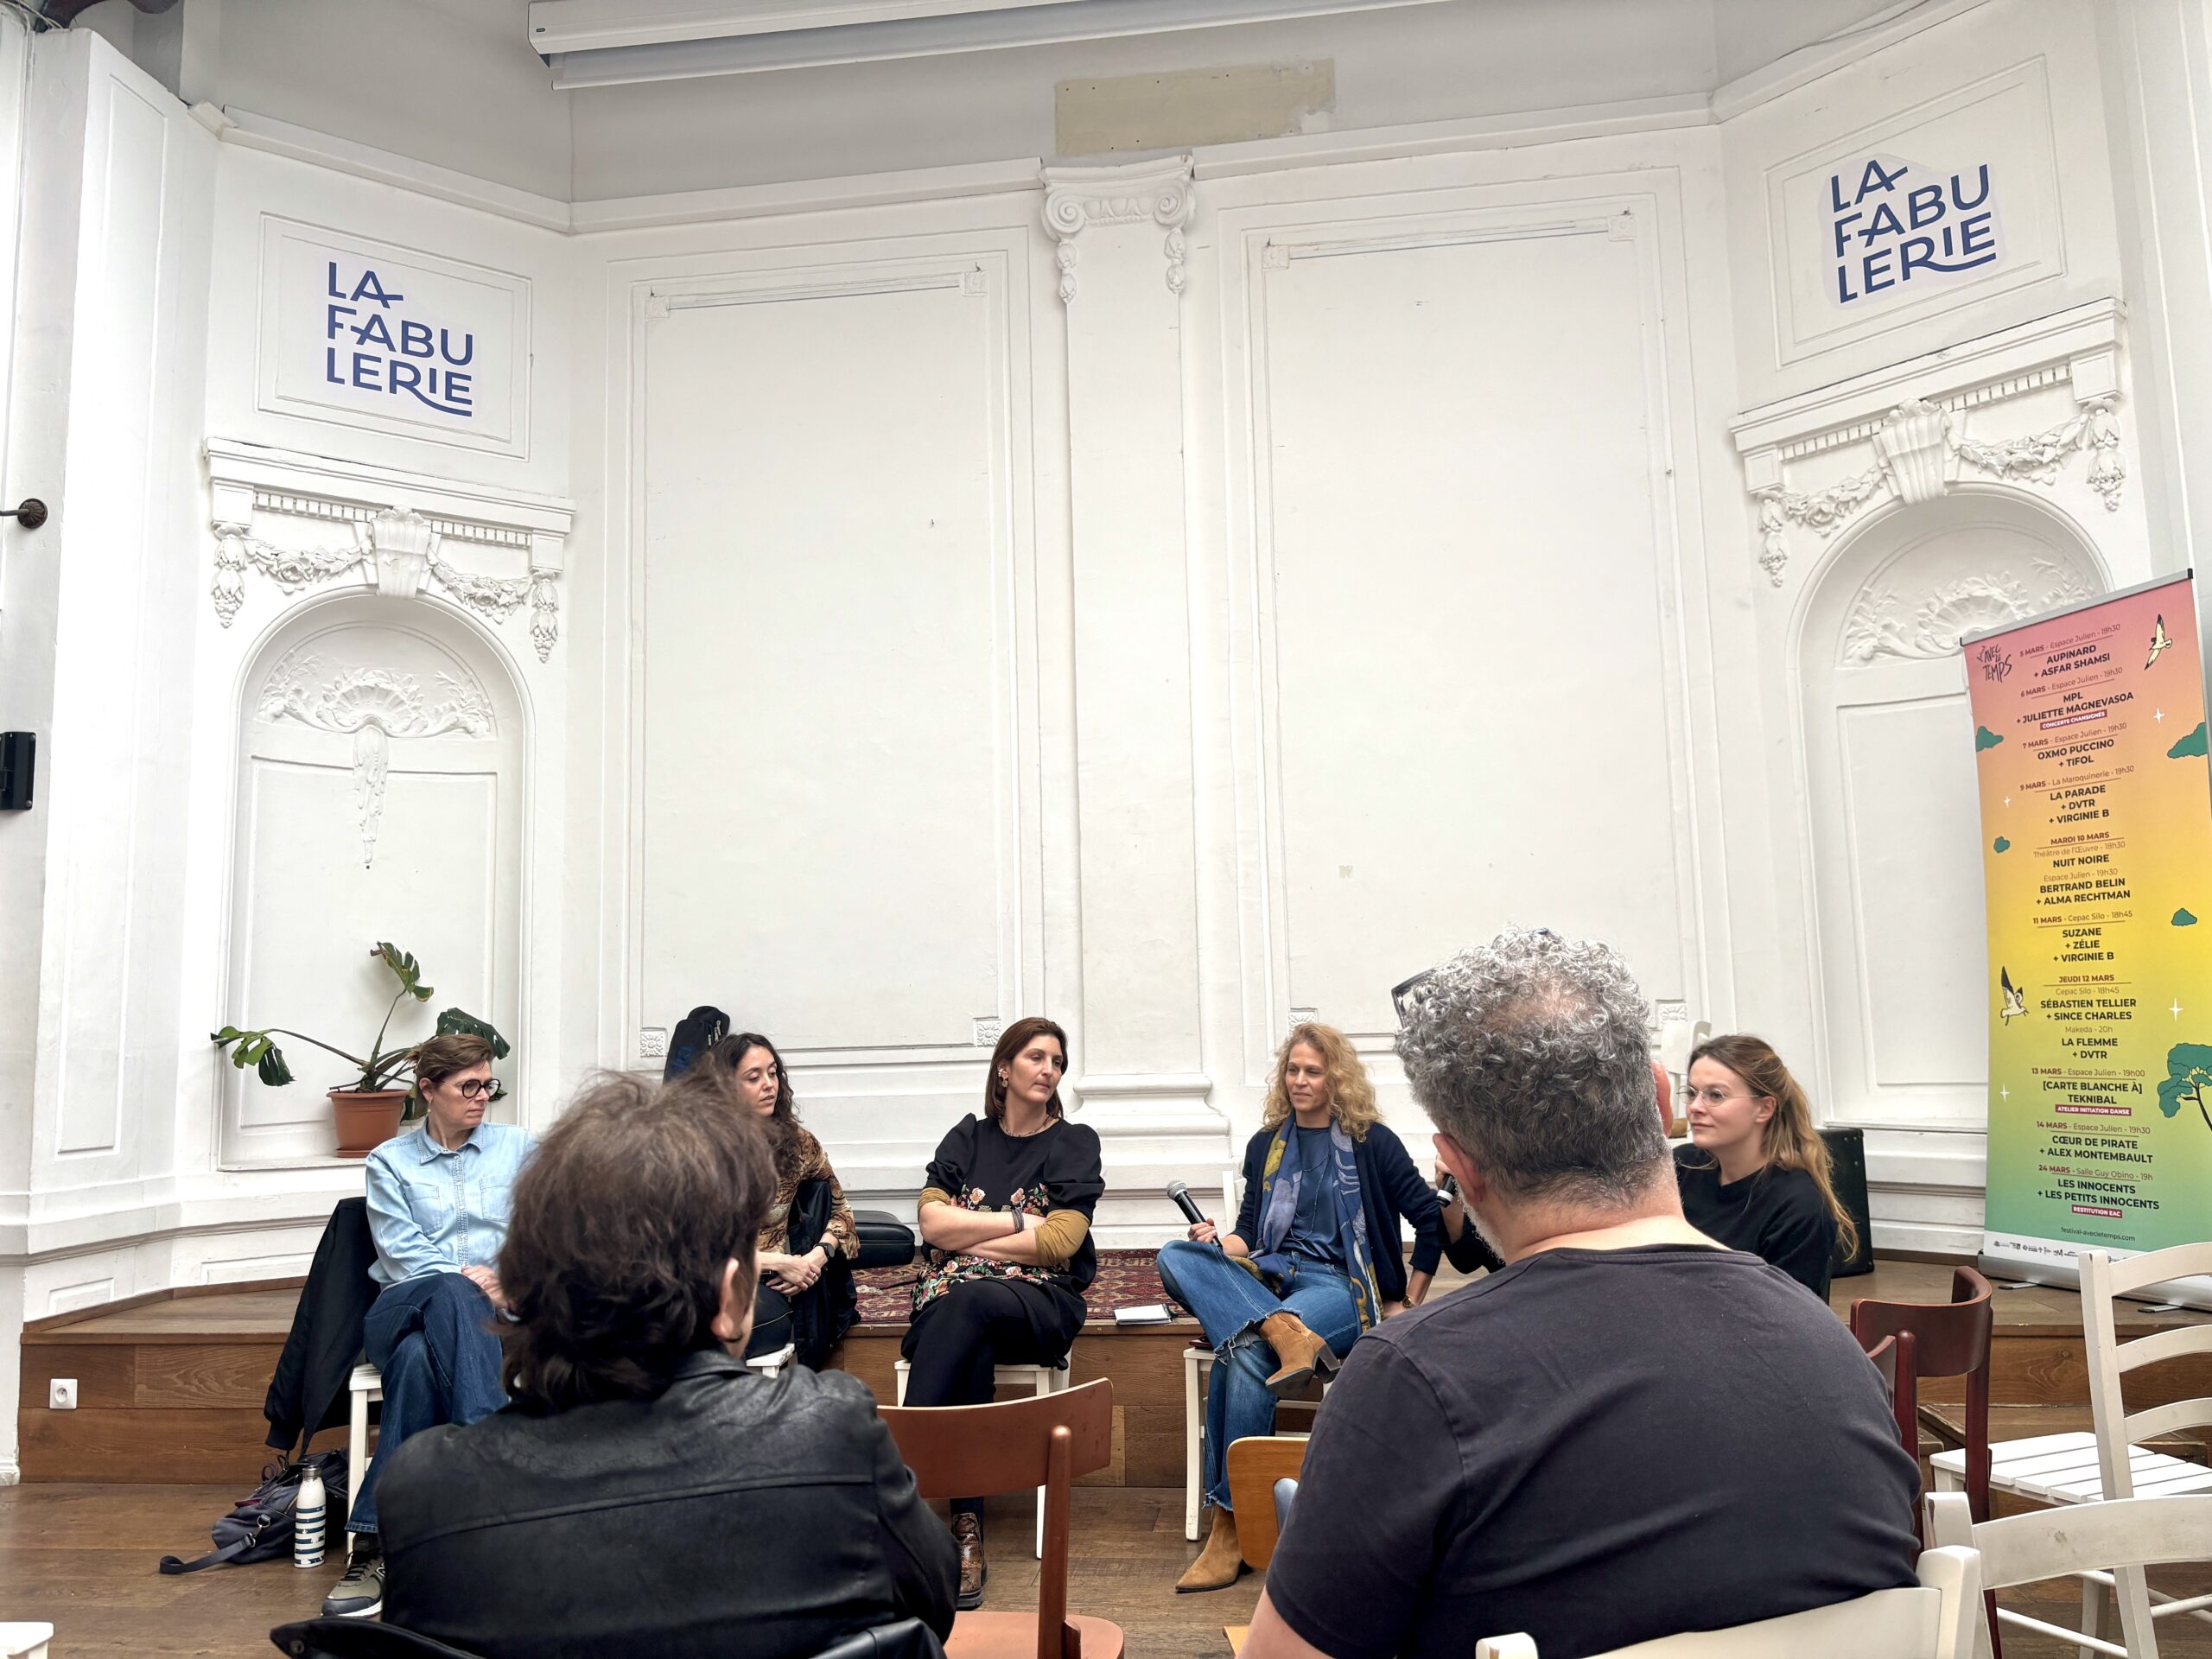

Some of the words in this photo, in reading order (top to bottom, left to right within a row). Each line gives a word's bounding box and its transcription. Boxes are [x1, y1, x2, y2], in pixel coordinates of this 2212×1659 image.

[1831, 160, 1908, 212] LA
[1835, 164, 1989, 258] FABU
[1838, 212, 1997, 304] LERIE
[328, 262, 404, 308] LA
[327, 304, 474, 365] FABU
[327, 347, 472, 416] LERIE
[2025, 645, 2044, 655] MARS
[2050, 637, 2074, 650] Espace
[2075, 631, 2095, 641] Julien
[2101, 624, 2120, 634] 19h30
[2047, 645, 2096, 664] AUPINARD
[1982, 654, 2012, 683] TEMPS
[2041, 664, 2071, 677] ASFAR
[2074, 653, 2110, 669] SHAMSI
[2026, 686, 2045, 696] MARS
[2051, 679, 2076, 691] Espace
[2078, 674, 2099, 684] Julien
[2104, 666, 2123, 677] 19h30
[2063, 693, 2083, 702] MPL
[2022, 708, 2063, 723] JULIETTE
[2066, 692, 2133, 715] MAGNEVASOA
[2042, 719, 2069, 729] CONCERTS
[2071, 711, 2106, 723] CHANSIGNÉS
[2028, 739, 2049, 748] MARS
[2055, 733, 2079, 744] Espace
[2081, 728, 2102, 738] Julien
[2108, 722, 2127, 734] 19h30
[2037, 749, 2067, 760] OXMO
[2069, 739, 2114, 754] PUCCINO
[2066, 756, 2094, 767] TIFOL
[2025, 781, 2046, 790] MARS
[2062, 771, 2110, 785] Maroquinerie
[2115, 766, 2134, 774] 19h30
[2050, 791, 2063, 801] LA
[2065, 785, 2106, 798] PARADE
[2069, 799, 2094, 809] DVTR
[2056, 810, 2099, 823] VIRGINIE
[2050, 836, 2075, 845] MARDI
[2087, 832, 2110, 841] MARS
[2034, 849, 2059, 858] Théâtre
[2105, 841, 2126, 850] 18h30
[2053, 858, 2075, 868] NUIT
[2078, 855, 2109, 866] NOIRE
[2070, 871, 2090, 880] Julien
[2040, 881, 2093, 893] BERTRAND
[2095, 878, 2126, 888] BELIN
[2044, 895, 2072, 906] ALMA
[2074, 890, 2131, 903] RECHTMAN
[2068, 915, 2090, 924] Cepac
[2063, 928, 2101, 938] SUZANE
[2073, 939, 2100, 949] ZÉLIE
[2062, 952, 2104, 963] VIRGINIE
[2041, 998, 2094, 1009] SÉBASTIEN
[2096, 999, 2137, 1007] TELLIER
[2054, 1012, 2082, 1020] SINCE
[2068, 1068, 2093, 1077] Espace
[2044, 1081, 2078, 1090] [CARTE
[2081, 1083, 2128, 1092] BLANCHE
[2132, 1081, 2142, 1094] À]
[2068, 1095, 2117, 1104] TEKNIBAL
[2052, 1135, 2082, 1146] CŒUR
[2085, 1138, 2099, 1147] DE
[2101, 1140, 2138, 1149] PIRATE
[2047, 1148, 2072, 1157] ALEX
[2074, 1150, 2153, 1163] MONTEMBAULT
[2095, 1170, 2109, 1179] Guy
[2111, 1171, 2134, 1179] Obino
[2058, 1179, 2075, 1188] LES
[2078, 1181, 2136, 1194] INNOCENTS
[2045, 1191, 2062, 1199] LES
[2064, 1192, 2097, 1203] PETITS
[2100, 1196, 2159, 1210] INNOCENTS
[2073, 1206, 2108, 1216] RESTITUTION
